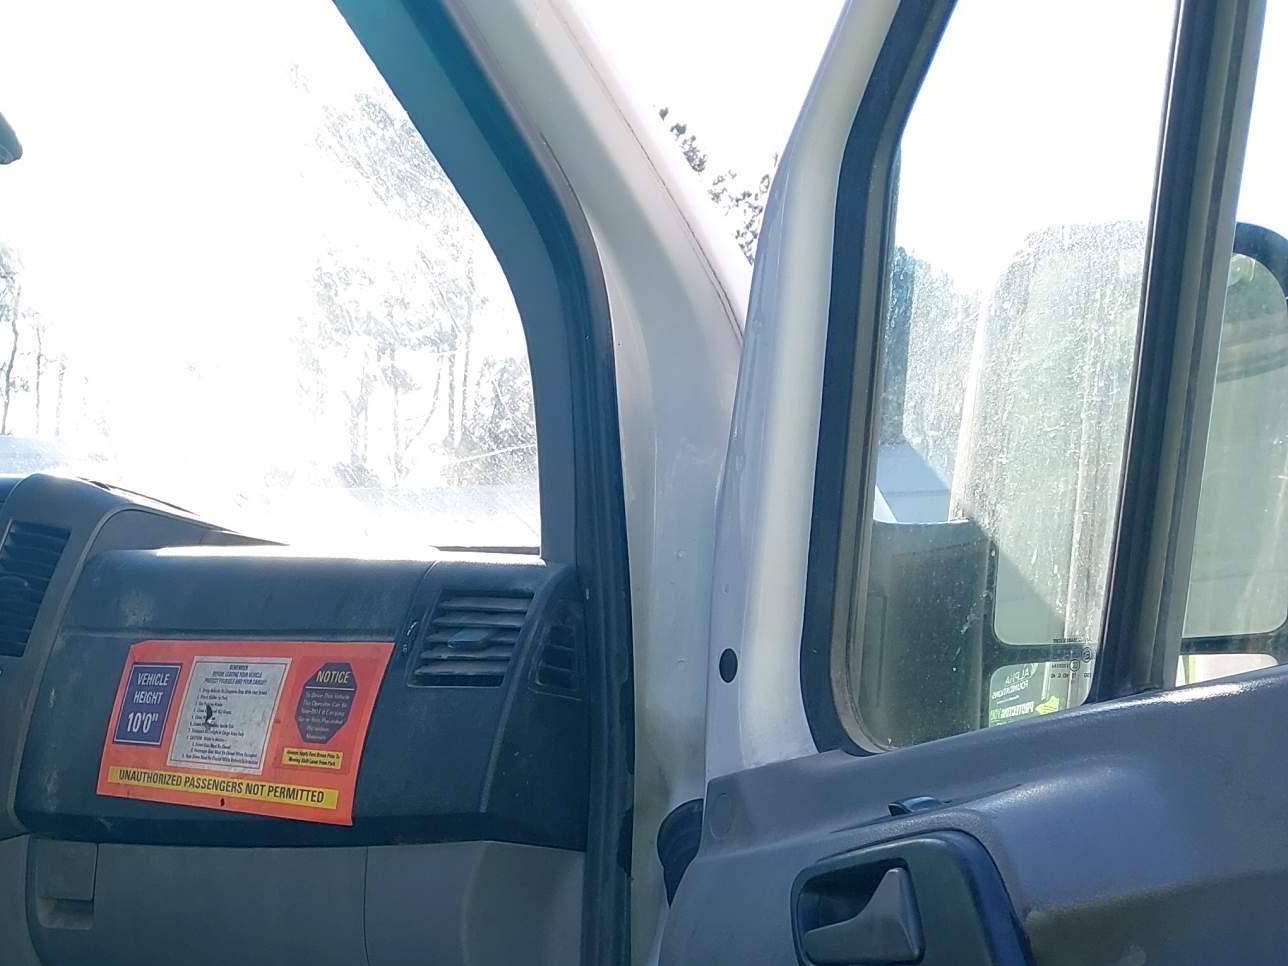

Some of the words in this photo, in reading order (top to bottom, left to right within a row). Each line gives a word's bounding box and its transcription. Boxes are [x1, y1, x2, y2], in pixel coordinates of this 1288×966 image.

[137, 672, 170, 686] VEHICLE
[315, 670, 352, 684] NOTICE
[133, 690, 164, 704] HEIGHT
[127, 712, 159, 734] 10'0"
[119, 769, 182, 787] UNAUTHORIZED
[184, 775, 243, 794] PASSENGERS
[245, 781, 266, 796] NOT
[267, 785, 324, 804] PERMITTED
